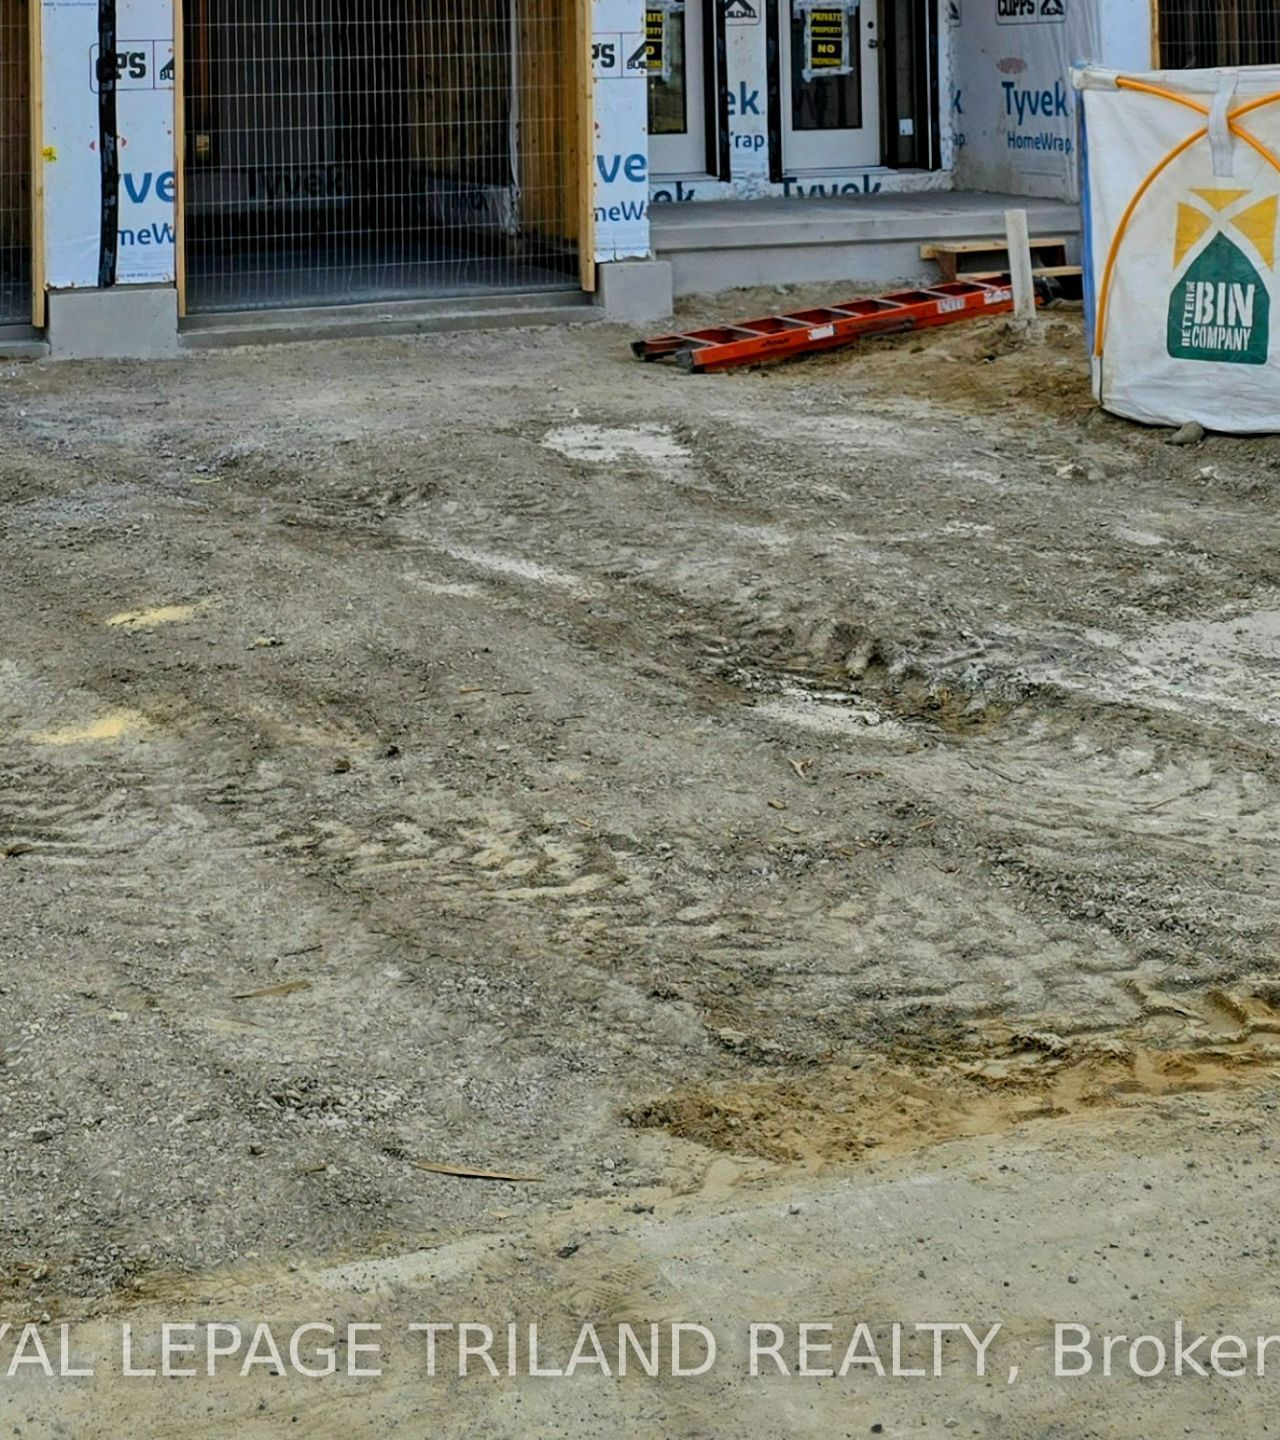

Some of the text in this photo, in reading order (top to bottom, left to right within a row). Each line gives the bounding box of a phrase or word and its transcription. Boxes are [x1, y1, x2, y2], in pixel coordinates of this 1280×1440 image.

[817, 44, 835, 53] NO
[1002, 81, 1066, 124] Tyvek
[1007, 132, 1072, 152] HomeWrap
[1194, 281, 1255, 327] BIN
[1191, 325, 1251, 351] COMPANY
